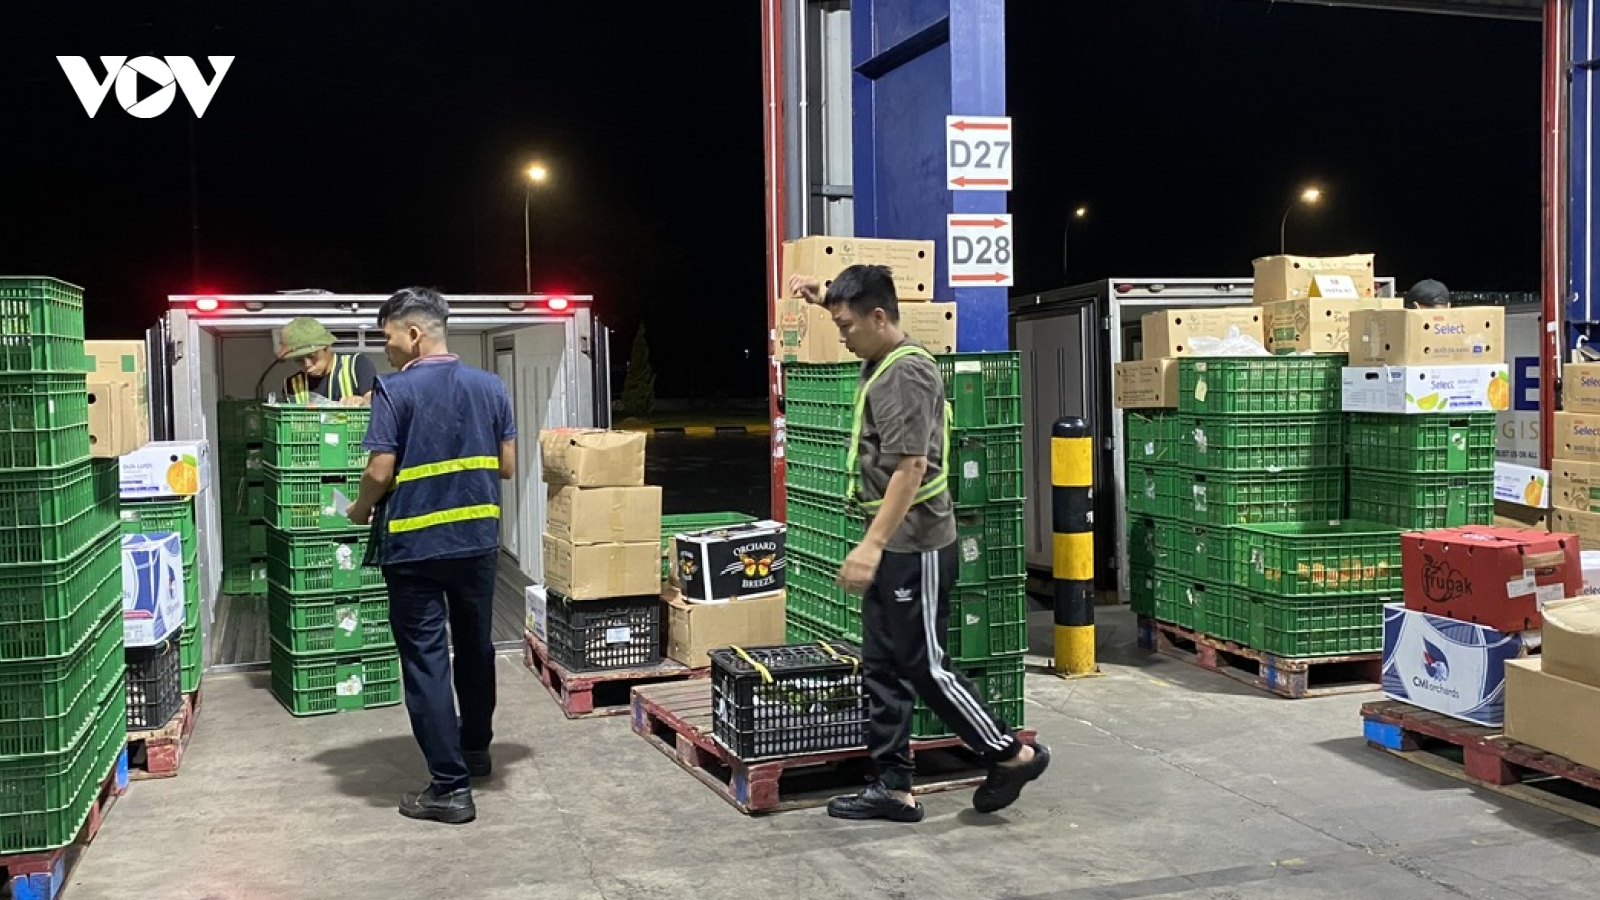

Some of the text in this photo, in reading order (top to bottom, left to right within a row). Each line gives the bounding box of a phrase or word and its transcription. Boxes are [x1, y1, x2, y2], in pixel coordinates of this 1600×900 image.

[950, 140, 1010, 168] D27
[952, 236, 1011, 264] D28
[1434, 323, 1466, 335] Select
[1431, 380, 1455, 391] Select
[733, 541, 777, 556] ORCHARD
[741, 574, 776, 588] BREEZE
[1424, 566, 1473, 596] frupak
[1412, 676, 1459, 699] CMI orchards
